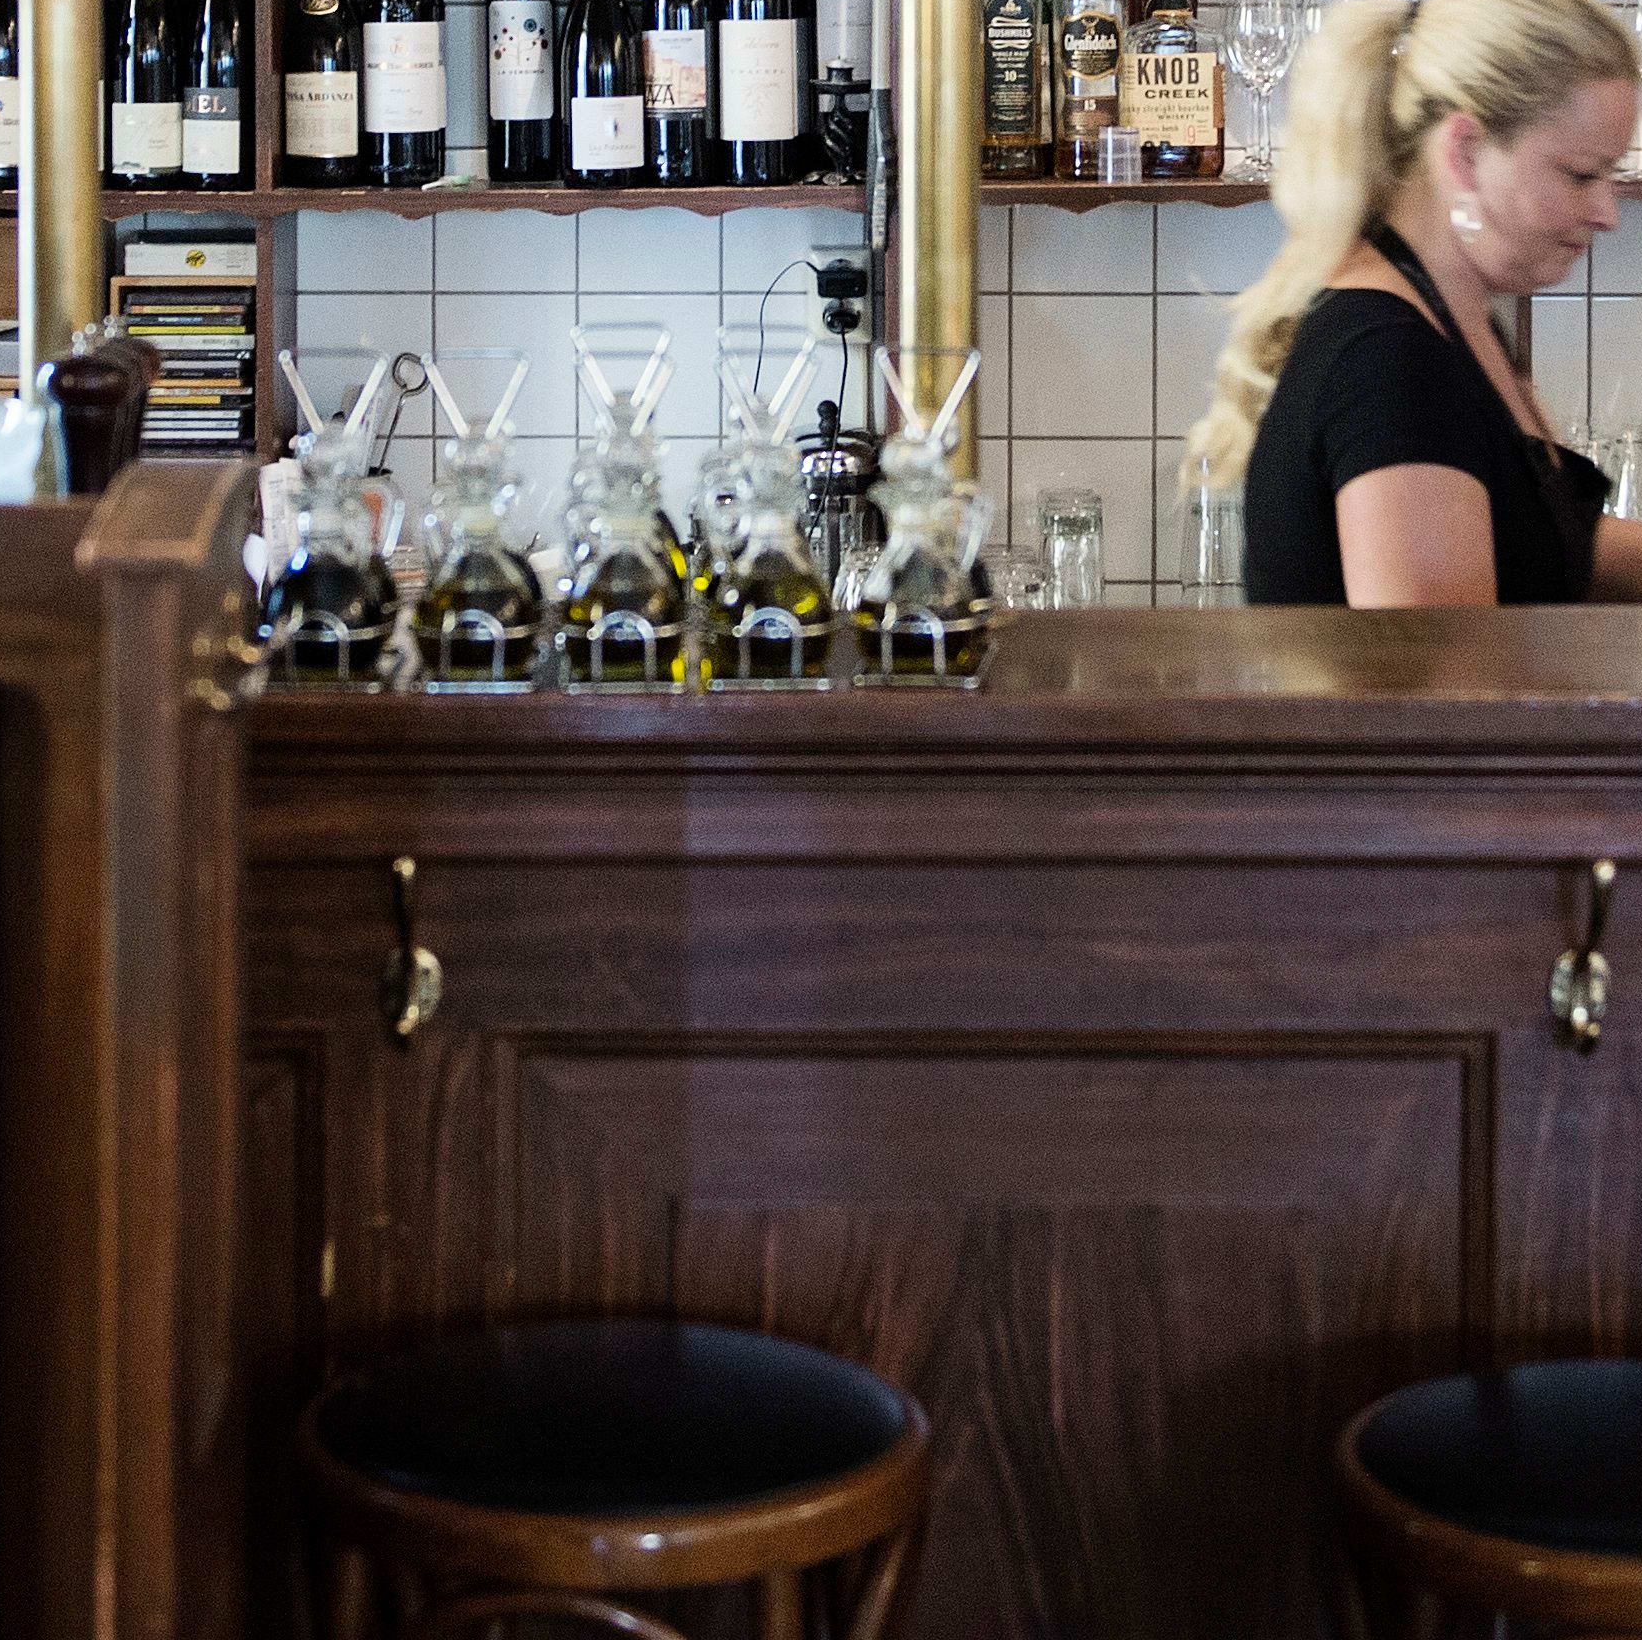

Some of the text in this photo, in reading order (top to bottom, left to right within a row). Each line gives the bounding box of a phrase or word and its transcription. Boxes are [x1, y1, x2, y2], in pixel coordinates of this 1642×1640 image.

[987, 28, 1032, 38] BUSHMILLS
[1064, 34, 1117, 51] Glenfiddich
[1004, 71, 1016, 82] 10
[1137, 58, 1200, 86] KNOB
[1144, 89, 1209, 99] CREEK
[1083, 99, 1096, 111] 15
[1186, 125, 1197, 145] 9
